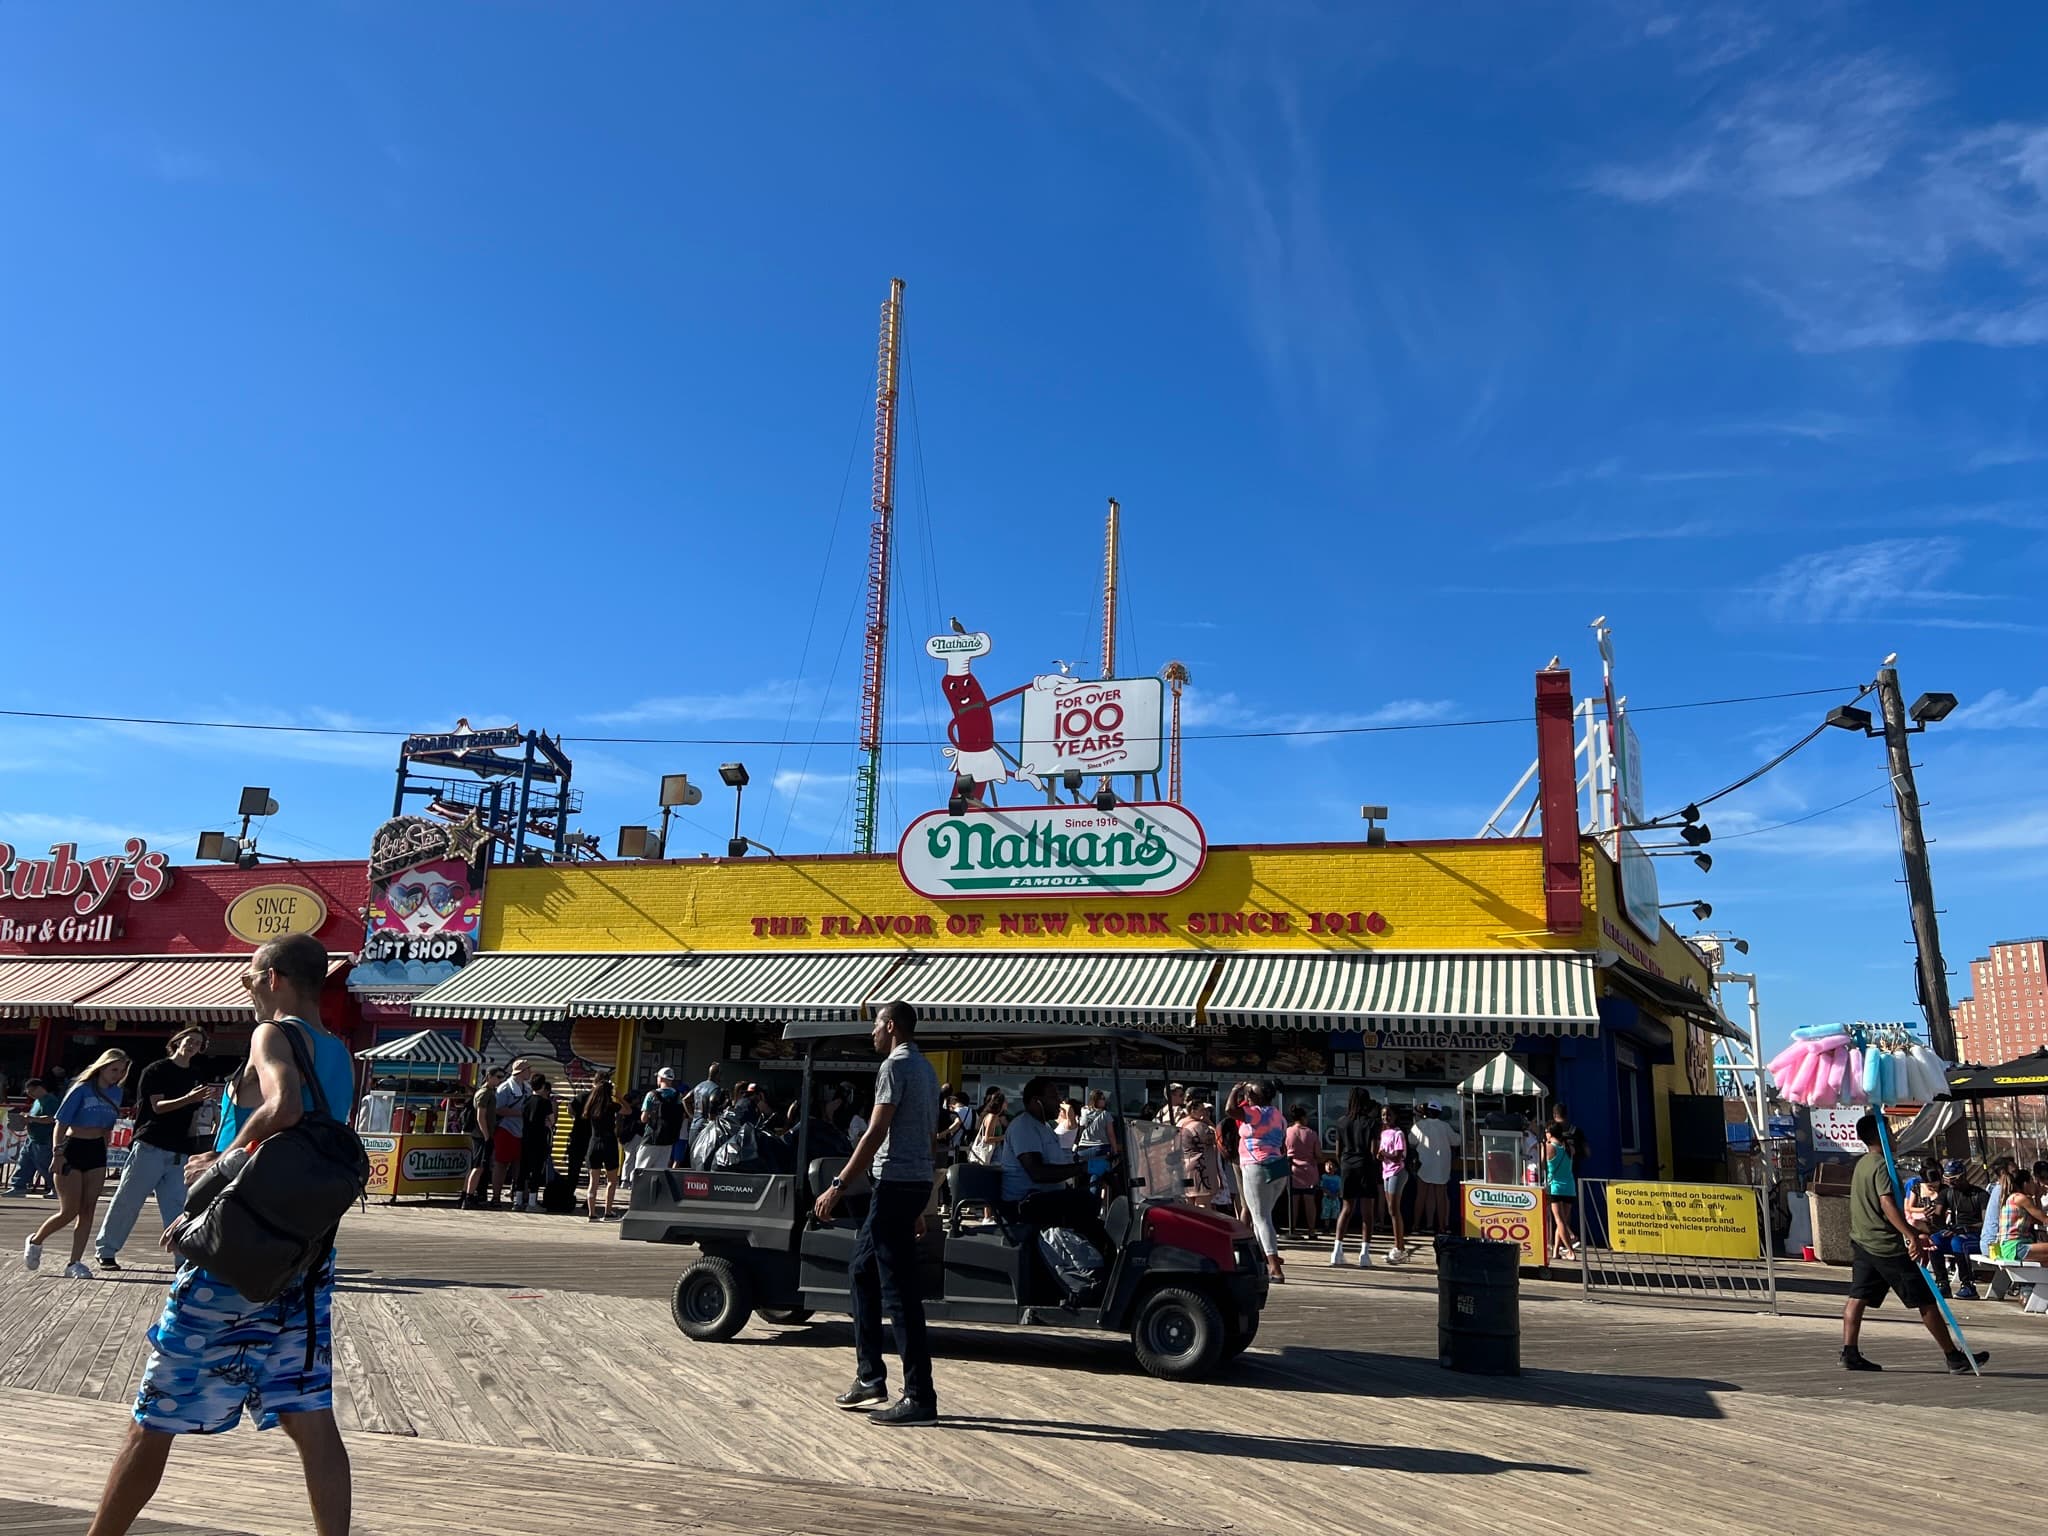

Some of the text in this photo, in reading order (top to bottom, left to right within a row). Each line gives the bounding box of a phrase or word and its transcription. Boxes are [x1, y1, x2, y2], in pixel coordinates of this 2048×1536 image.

[932, 636, 981, 650] Nathan's
[1056, 689, 1121, 710] FOR OVER
[1055, 703, 1124, 740] 100
[1053, 732, 1124, 757] YEARS
[1065, 817, 1118, 828] Since 1916
[405, 823, 446, 851] Star
[927, 817, 1172, 871] Nathan's
[0, 837, 169, 915] uby's
[1010, 876, 1090, 887] FAMOUS
[255, 897, 297, 915] SINCE
[0, 915, 113, 943] Bar & Grill
[257, 916, 290, 933] 1934
[751, 911, 1386, 936] THE FLAVOR OF NEW YORK SINCE 1916
[408, 940, 458, 960] SHOP
[1193, 1025, 1228, 1035] HERE
[1385, 1032, 1513, 1050] Auntie Anne's
[1815, 1123, 1858, 1141] CLOSE
[409, 1151, 467, 1171] Nathan's
[368, 1177, 389, 1185] ARS
[713, 1184, 754, 1193] WORKMAN
[1474, 1189, 1531, 1205] Nathan's
[1615, 1188, 1648, 1197] Bicycles
[1650, 1190, 1688, 1200] permitted
[1702, 1192, 1743, 1201] boardwalk
[1616, 1198, 1636, 1206] 6:00
[1707, 1202, 1727, 1212] only.
[1502, 1216, 1527, 1224] OVER
[1617, 1211, 1655, 1221] Motorized
[1682, 1215, 1717, 1223] scooters
[1480, 1223, 1530, 1241] 100
[1617, 1220, 1746, 1234] unauthorized vehicles prohibited
[1638, 1229, 1662, 1237] times.
